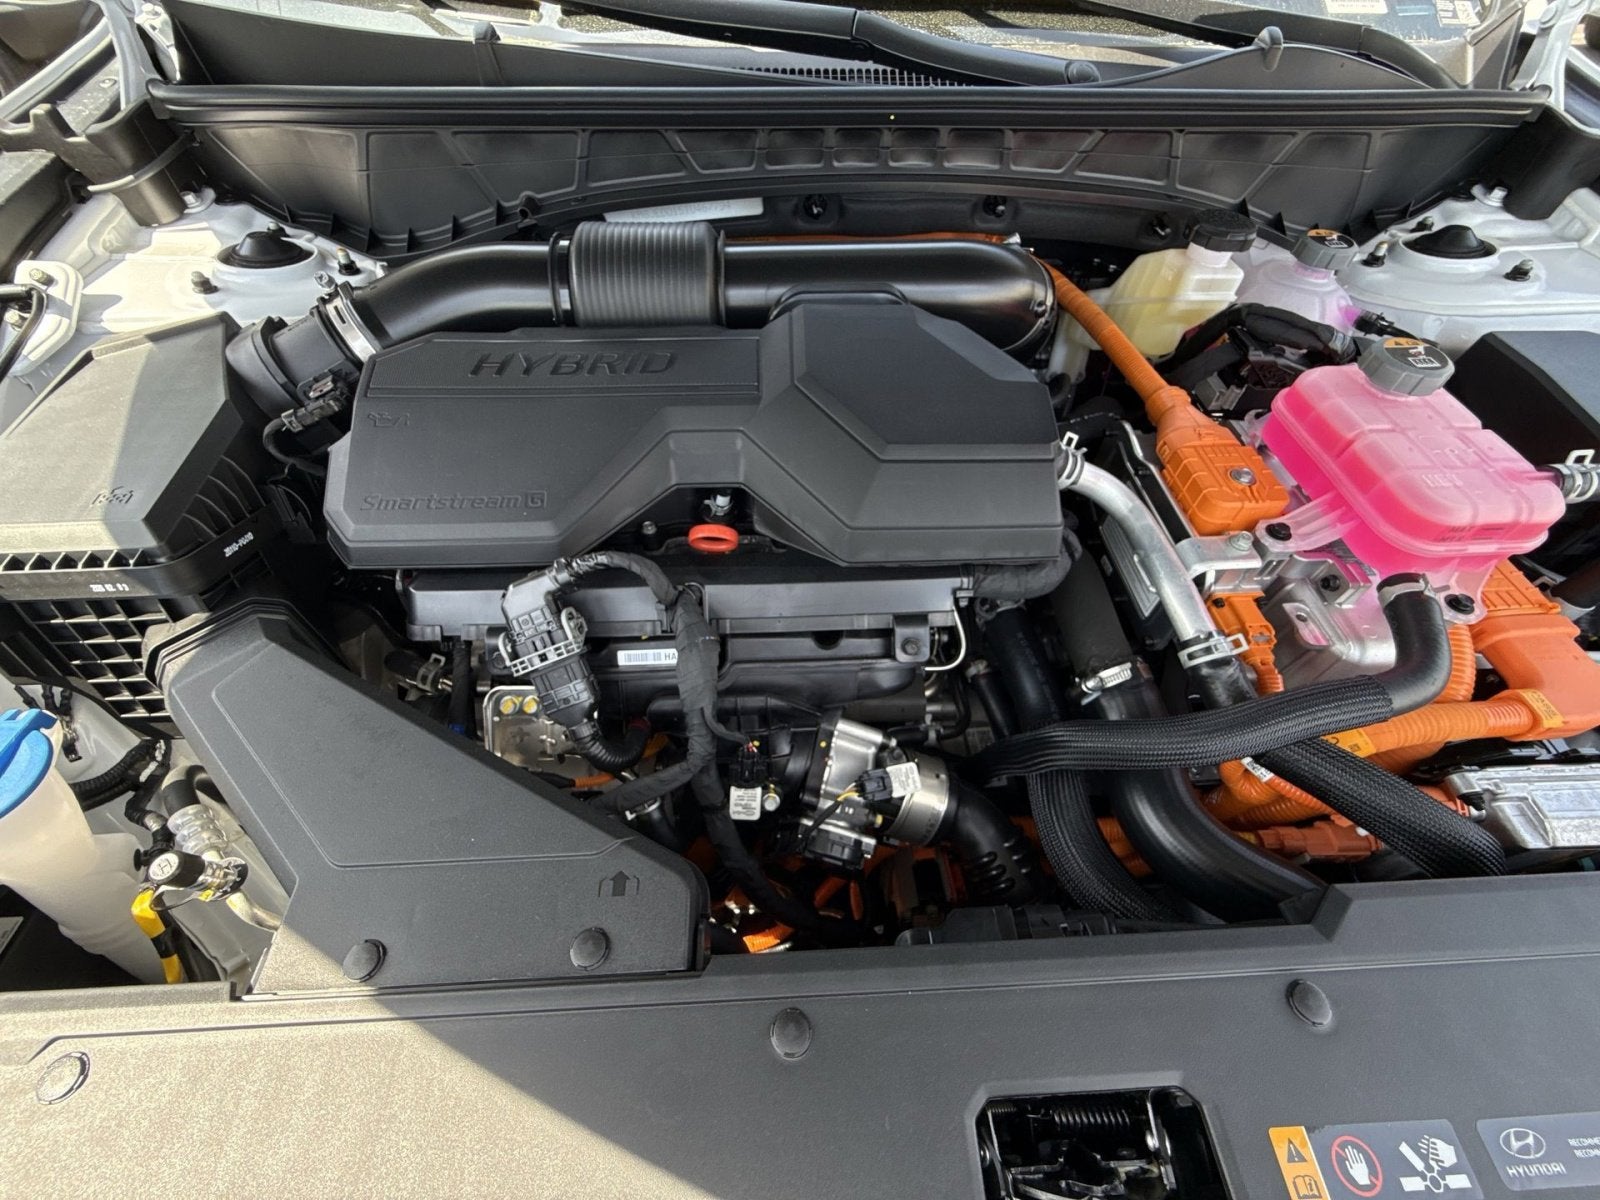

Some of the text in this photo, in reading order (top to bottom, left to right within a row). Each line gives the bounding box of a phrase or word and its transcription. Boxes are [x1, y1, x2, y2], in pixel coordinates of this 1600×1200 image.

[468, 353, 677, 377] HYBRID
[360, 493, 521, 511] Smartstream
[1506, 1162, 1567, 1178] HYUNDAI
